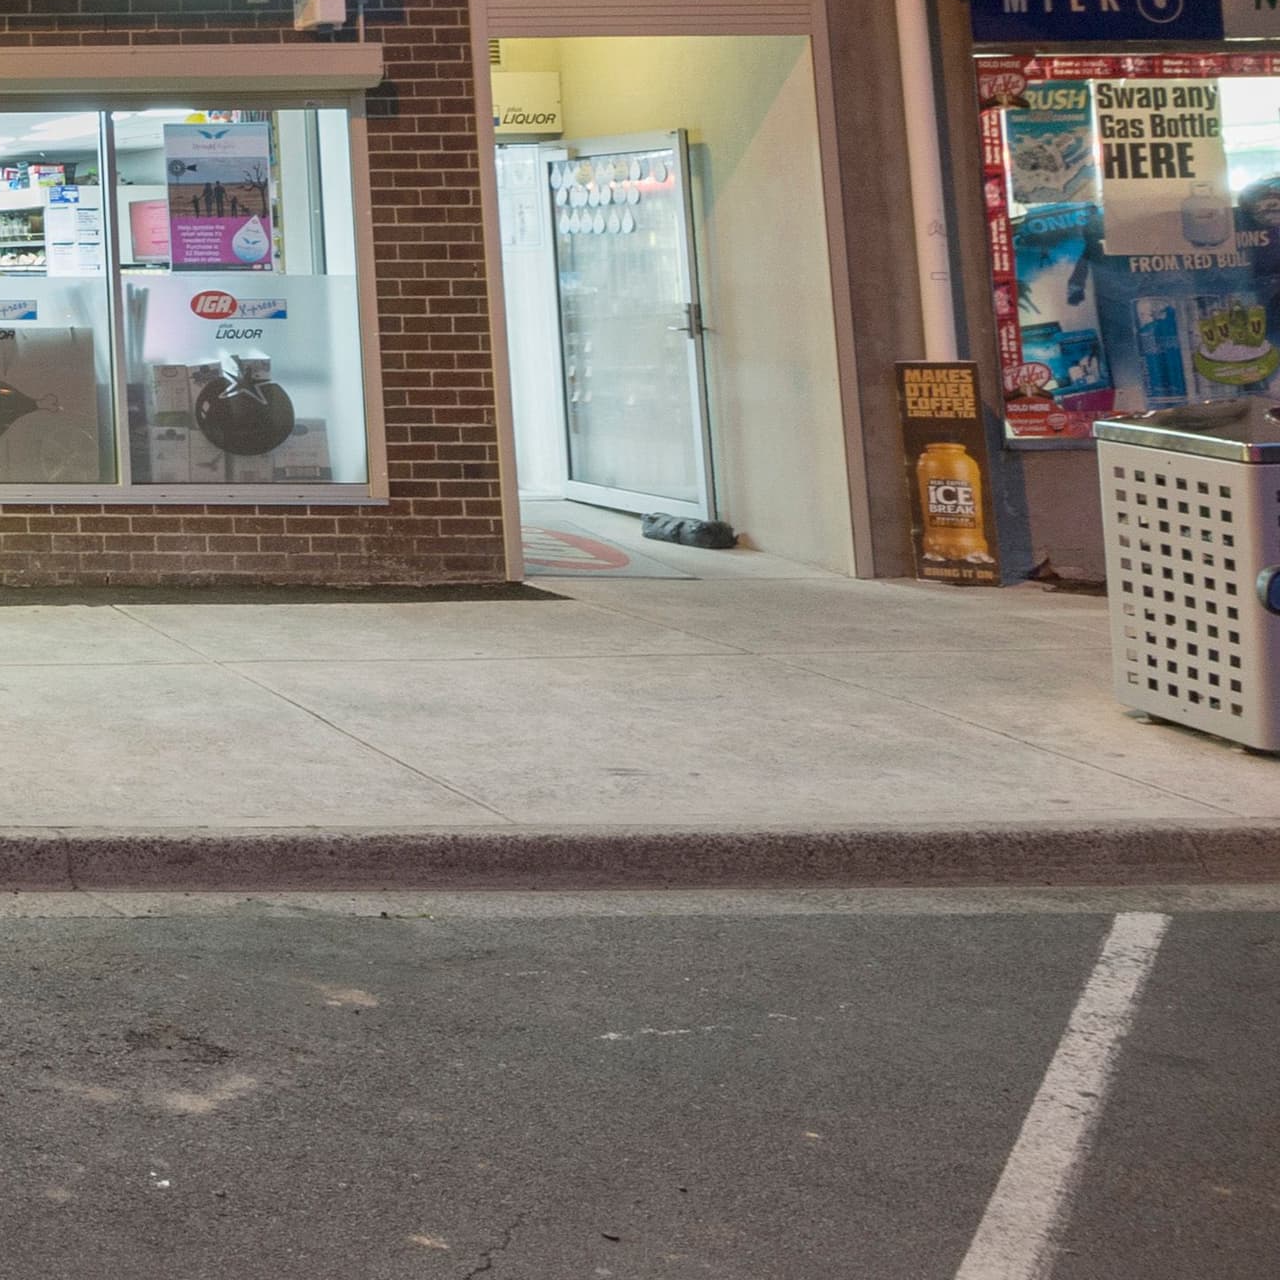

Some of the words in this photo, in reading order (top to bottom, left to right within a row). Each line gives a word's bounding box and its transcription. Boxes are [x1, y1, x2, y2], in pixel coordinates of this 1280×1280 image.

[1096, 83, 1168, 112] Swap
[1172, 85, 1218, 111] any
[502, 113, 557, 125] LIQUOR
[1099, 114, 1145, 139] Gas
[1149, 113, 1220, 139] Bottle
[1102, 142, 1197, 179] HERE
[1129, 256, 1180, 273] FROM
[1183, 254, 1212, 270] RED
[195, 295, 233, 314] IGA
[215, 329, 263, 340] LIQUOR
[903, 368, 974, 383] MAKES
[905, 383, 975, 398] OTHER
[906, 397, 977, 411] COFFEE
[928, 485, 974, 505] ICE
[928, 504, 976, 515] BREAK
